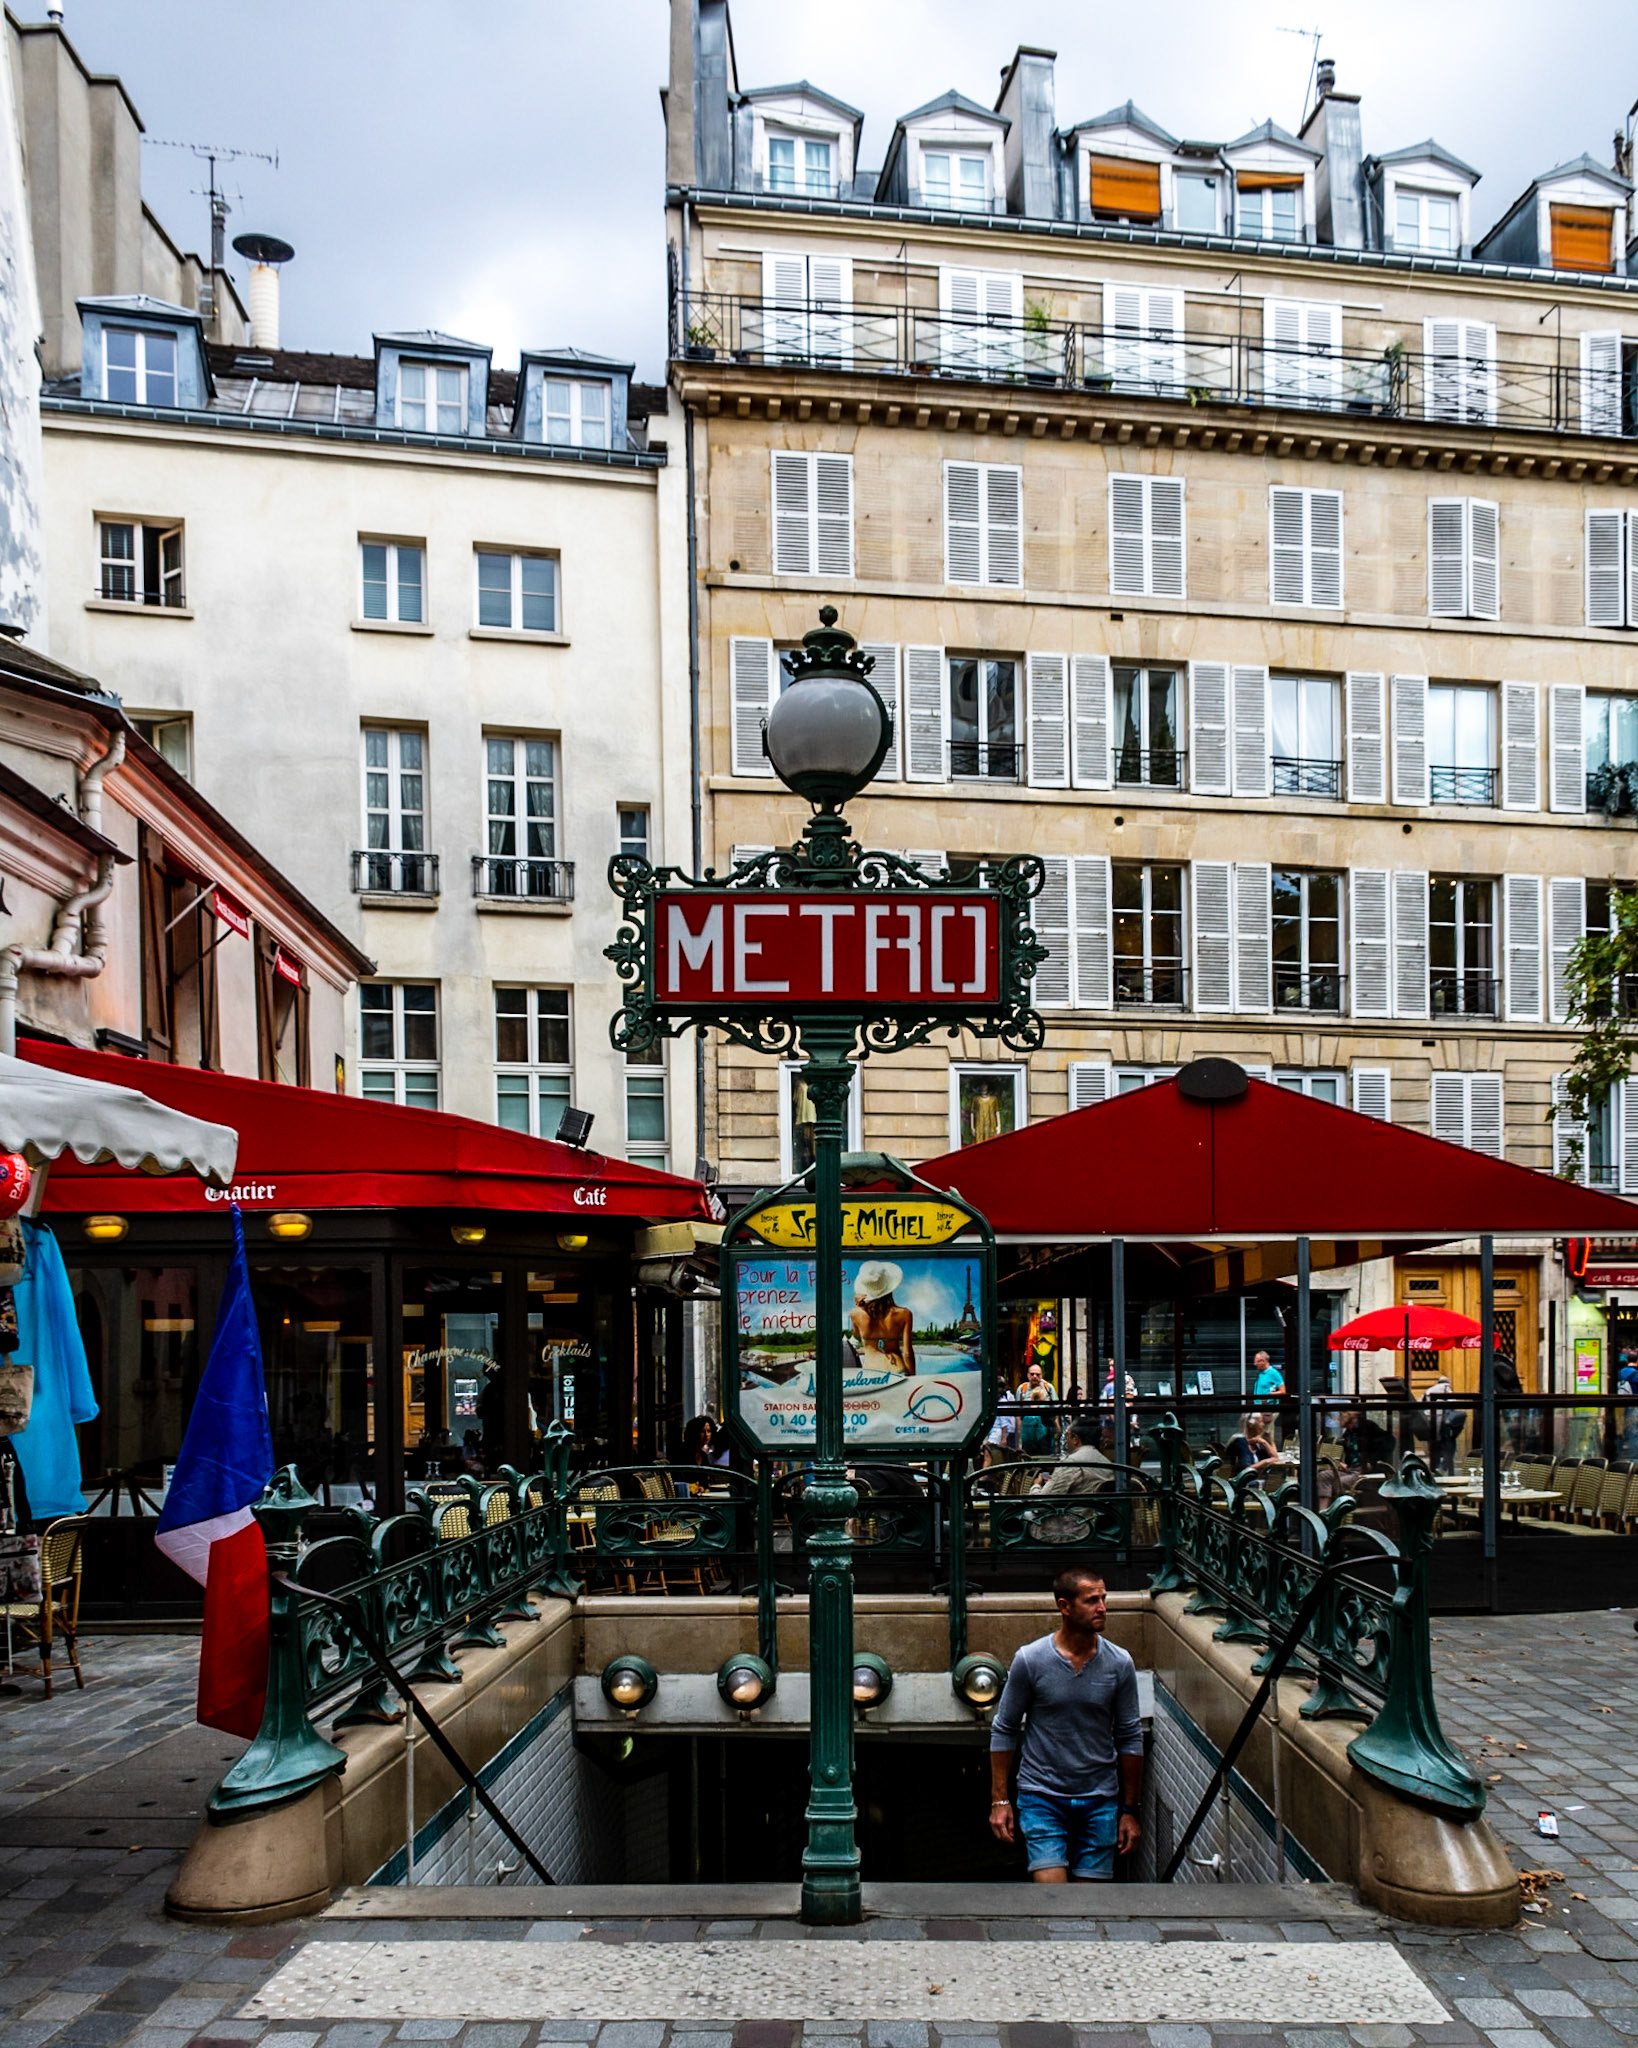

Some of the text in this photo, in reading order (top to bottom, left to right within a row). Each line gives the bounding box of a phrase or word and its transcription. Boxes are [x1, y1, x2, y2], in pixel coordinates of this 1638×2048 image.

[667, 904, 987, 994] METRO
[573, 1186, 607, 1206] Café
[736, 1263, 777, 1284] Pour
[785, 1264, 799, 1284] la
[736, 1289, 802, 1310] prenez
[738, 1309, 752, 1330] le
[541, 1341, 592, 1363] Cocktails
[763, 1402, 800, 1412] STATION
[769, 1414, 785, 1426] 01
[790, 1414, 807, 1426] 40
[850, 1413, 868, 1426] 00
